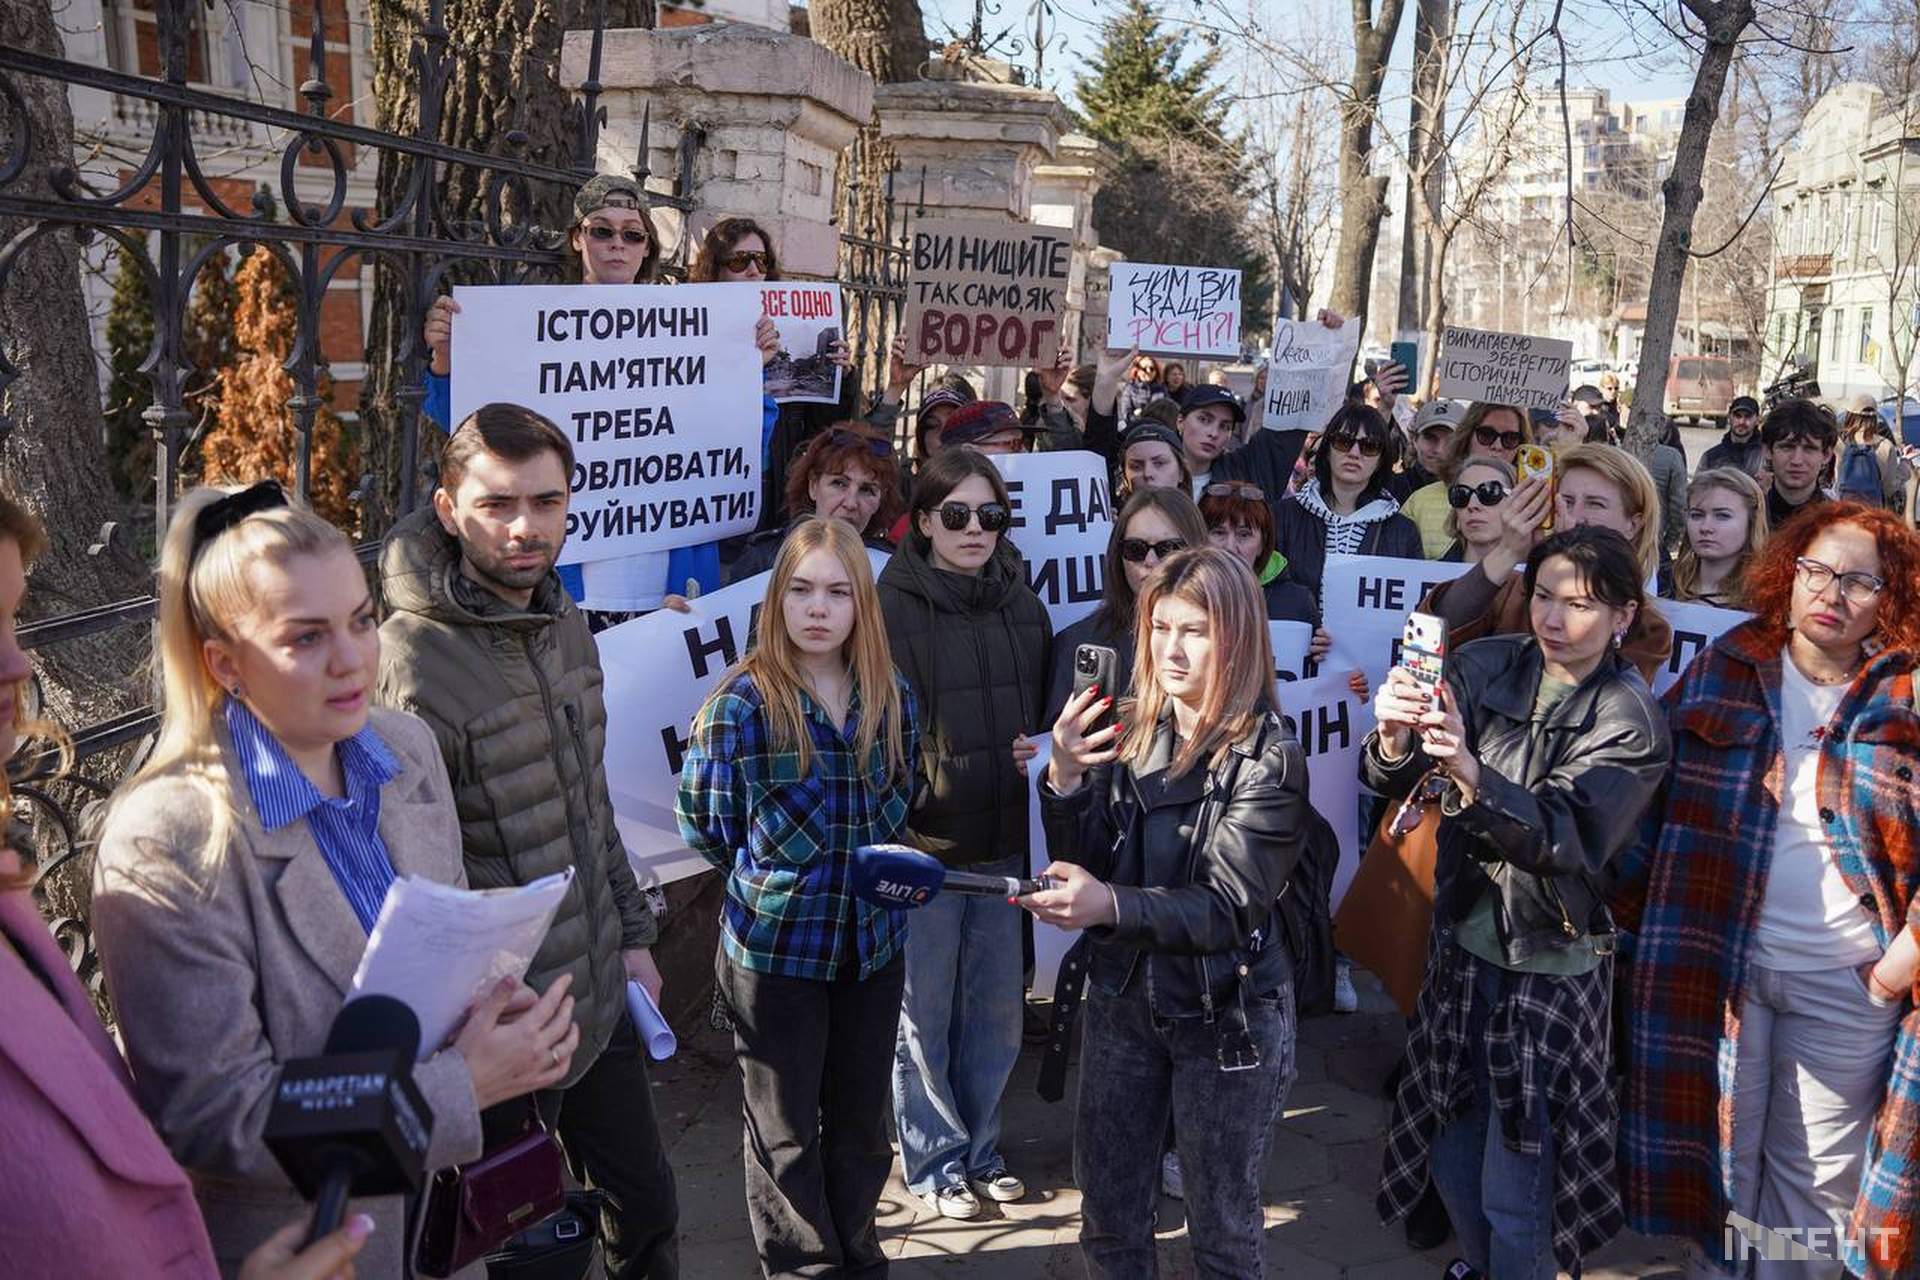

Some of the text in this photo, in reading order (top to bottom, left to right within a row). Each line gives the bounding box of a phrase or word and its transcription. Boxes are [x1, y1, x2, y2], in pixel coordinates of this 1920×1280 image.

[914, 233, 1071, 280] ВИ НИЩИТЕ
[914, 281, 1056, 314] ТАК САМО, ЯК
[1129, 267, 1237, 300] ЧИМ ВИ
[790, 290, 833, 320] ОДНО
[1133, 291, 1217, 322] КРАЩЕ
[536, 307, 709, 342] ІСТОРИЧНІ
[919, 308, 1056, 360] ВОРОГ
[1128, 311, 1234, 350] РУСНІ?!
[1446, 329, 1532, 351] ВИМАГАЄМО
[538, 355, 706, 394] ПАМ’ЯТКИ
[1444, 358, 1529, 387] ІСТОРИЧНІ
[1487, 350, 1567, 378] ЗБЕРЕГТИ
[1268, 389, 1311, 416] НАША
[571, 406, 676, 442] ТРЕБА
[1044, 477, 1111, 536] ДА
[1357, 576, 1405, 611] НЕ
[1284, 701, 1350, 756] ІН
[875, 879, 913, 899] LIVE
